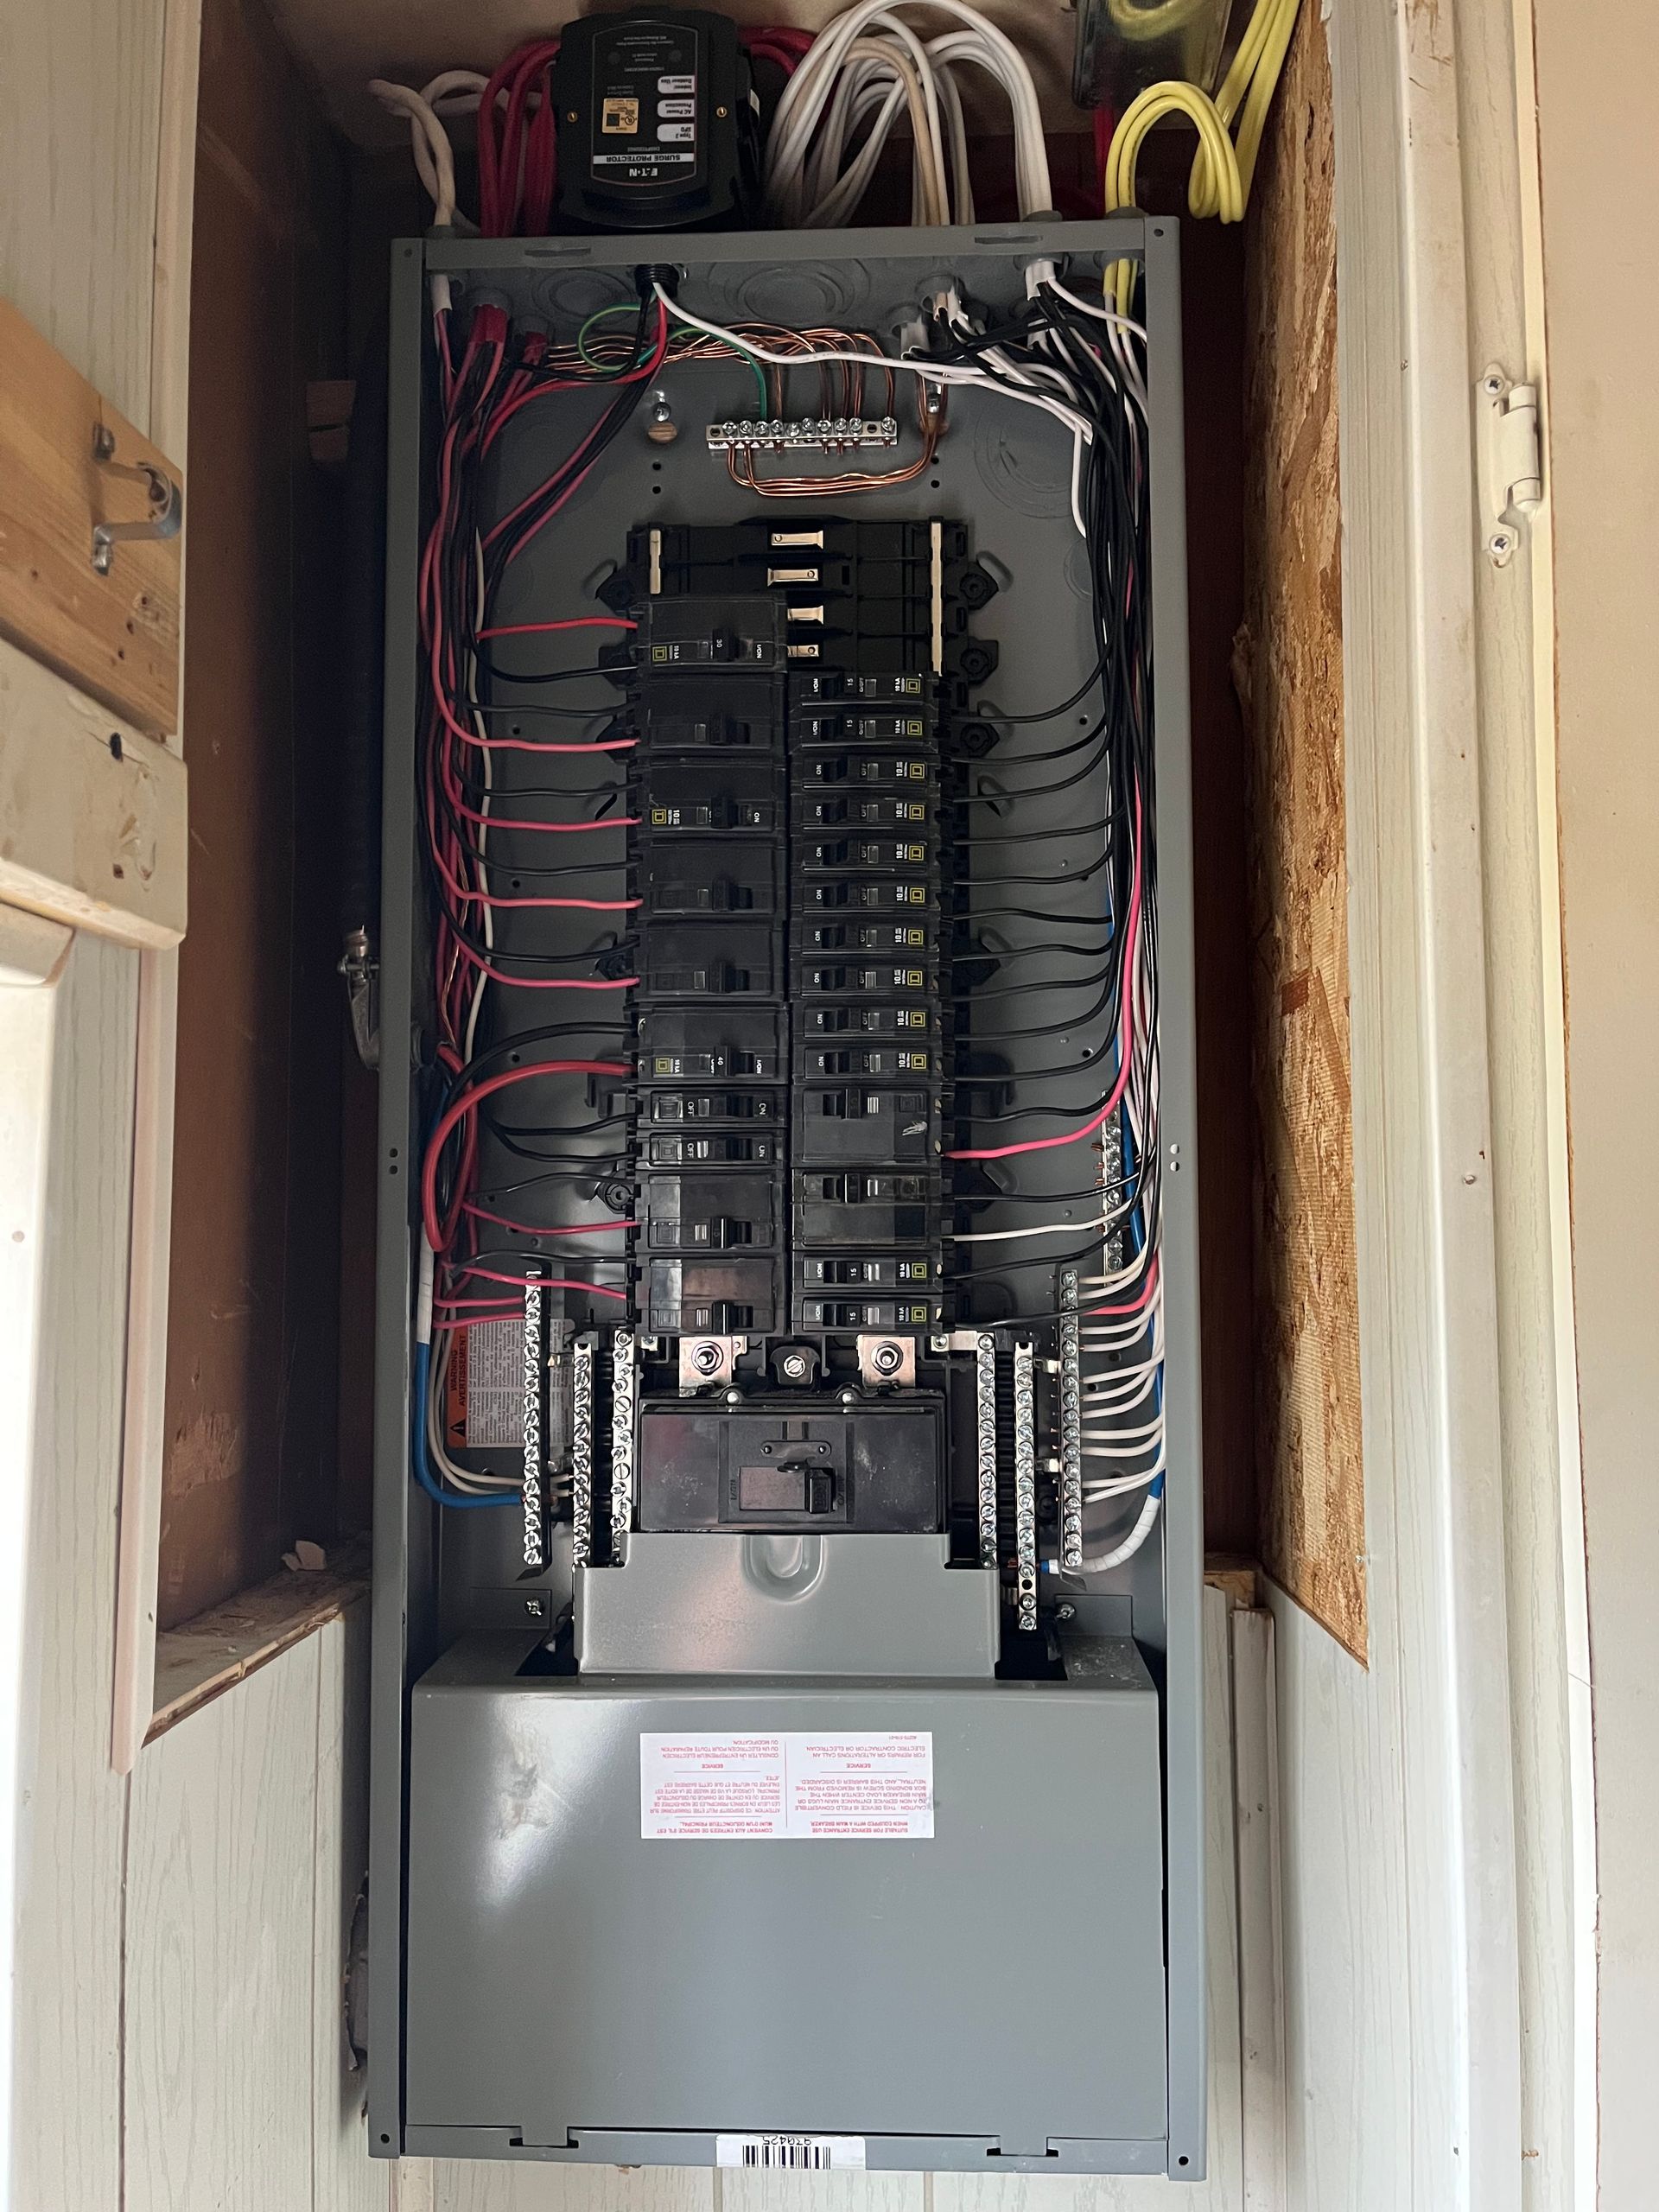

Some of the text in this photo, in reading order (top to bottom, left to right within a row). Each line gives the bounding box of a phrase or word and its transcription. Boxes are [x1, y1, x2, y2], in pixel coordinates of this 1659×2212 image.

[716, 639, 722, 648] 30
[816, 765, 821, 775] ON
[816, 806, 821, 816] ON
[754, 812, 760, 822] ON
[816, 847, 821, 857] ON
[816, 889, 822, 899] ON
[815, 931, 820, 941] ON
[814, 973, 819, 983] ON
[817, 1014, 823, 1024] ON
[717, 1056, 723, 1065] 40
[818, 1056, 824, 1067] ON
[759, 1103, 765, 1115] ON
[759, 1145, 765, 1157] ON
[851, 1268, 856, 1276] 15
[850, 1312, 856, 1320] 15
